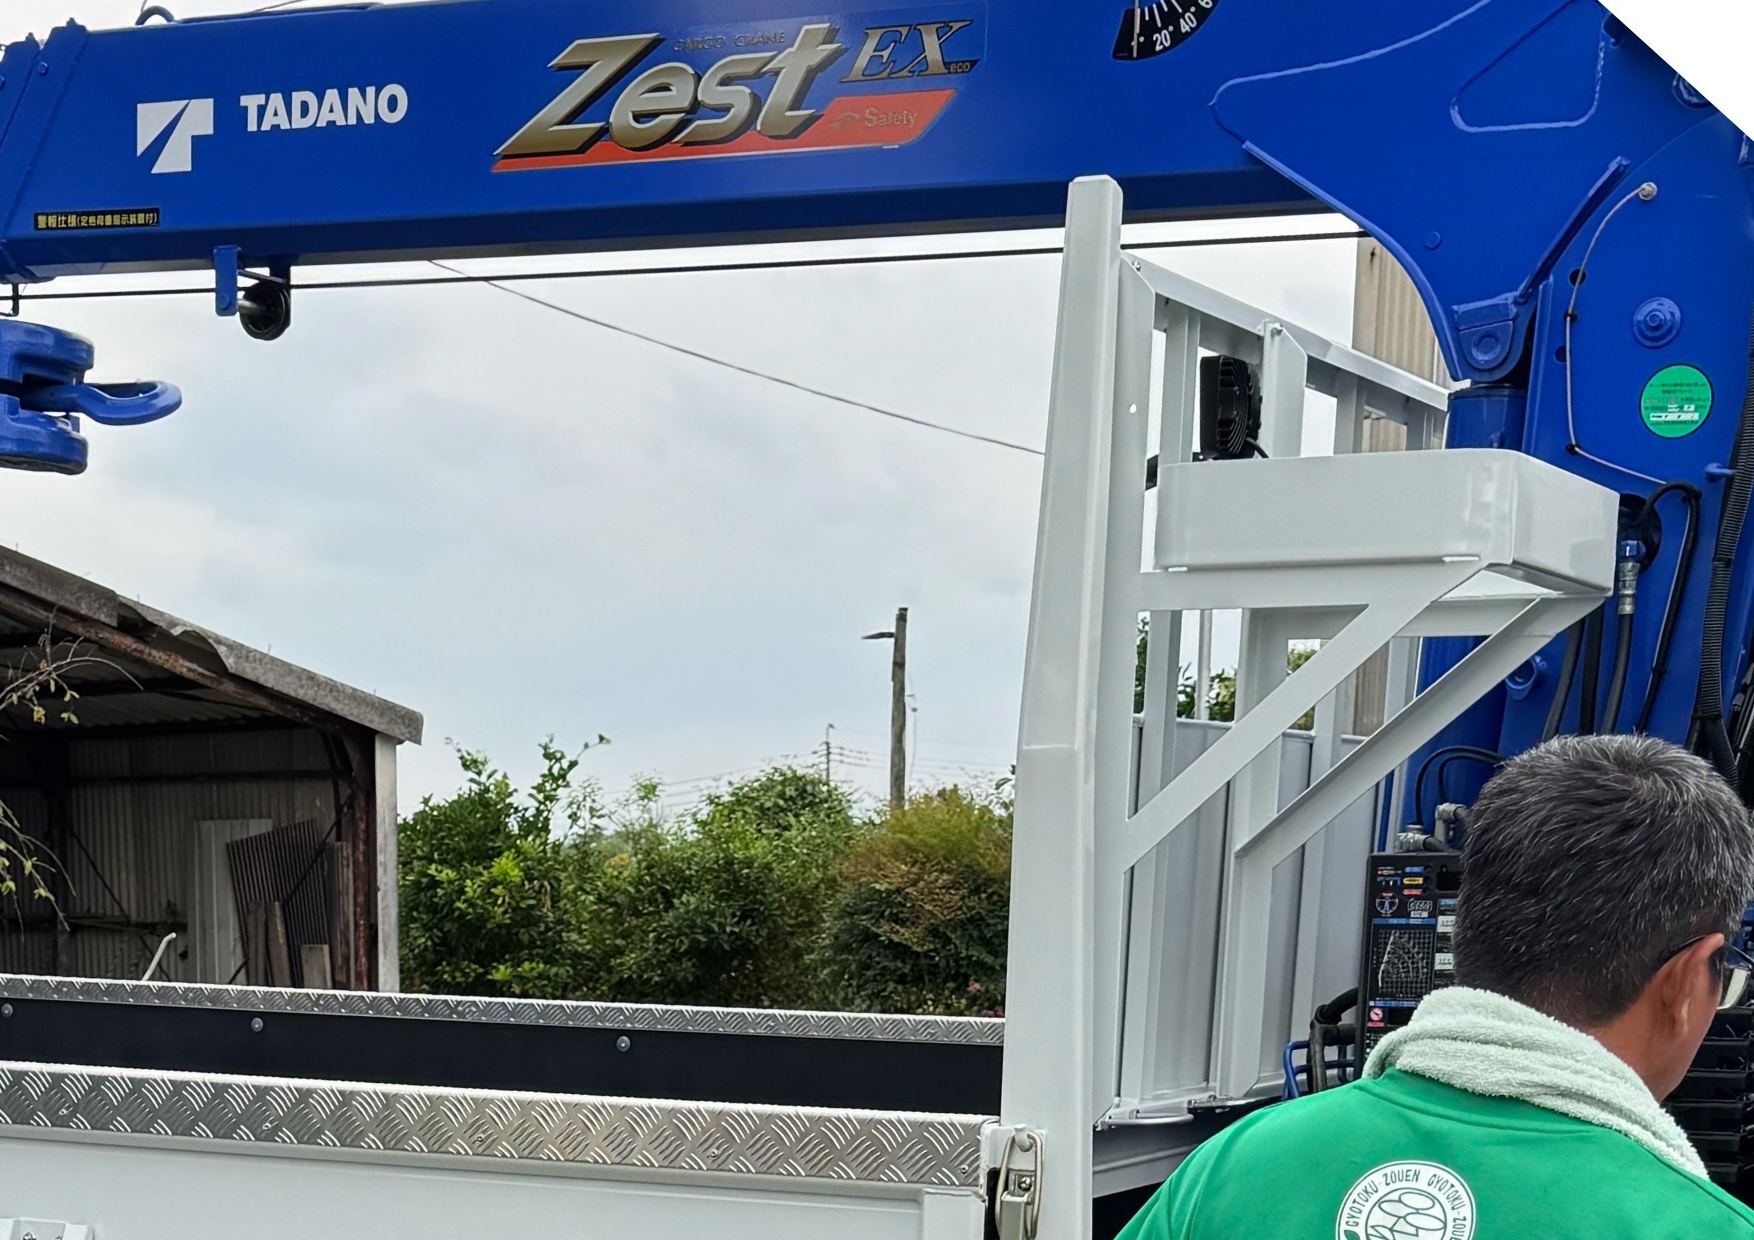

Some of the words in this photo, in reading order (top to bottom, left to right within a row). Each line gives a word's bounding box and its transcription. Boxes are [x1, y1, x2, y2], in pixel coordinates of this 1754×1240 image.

[840, 19, 974, 82] EX
[240, 83, 408, 132] TADANO
[493, 22, 848, 155] Zest
